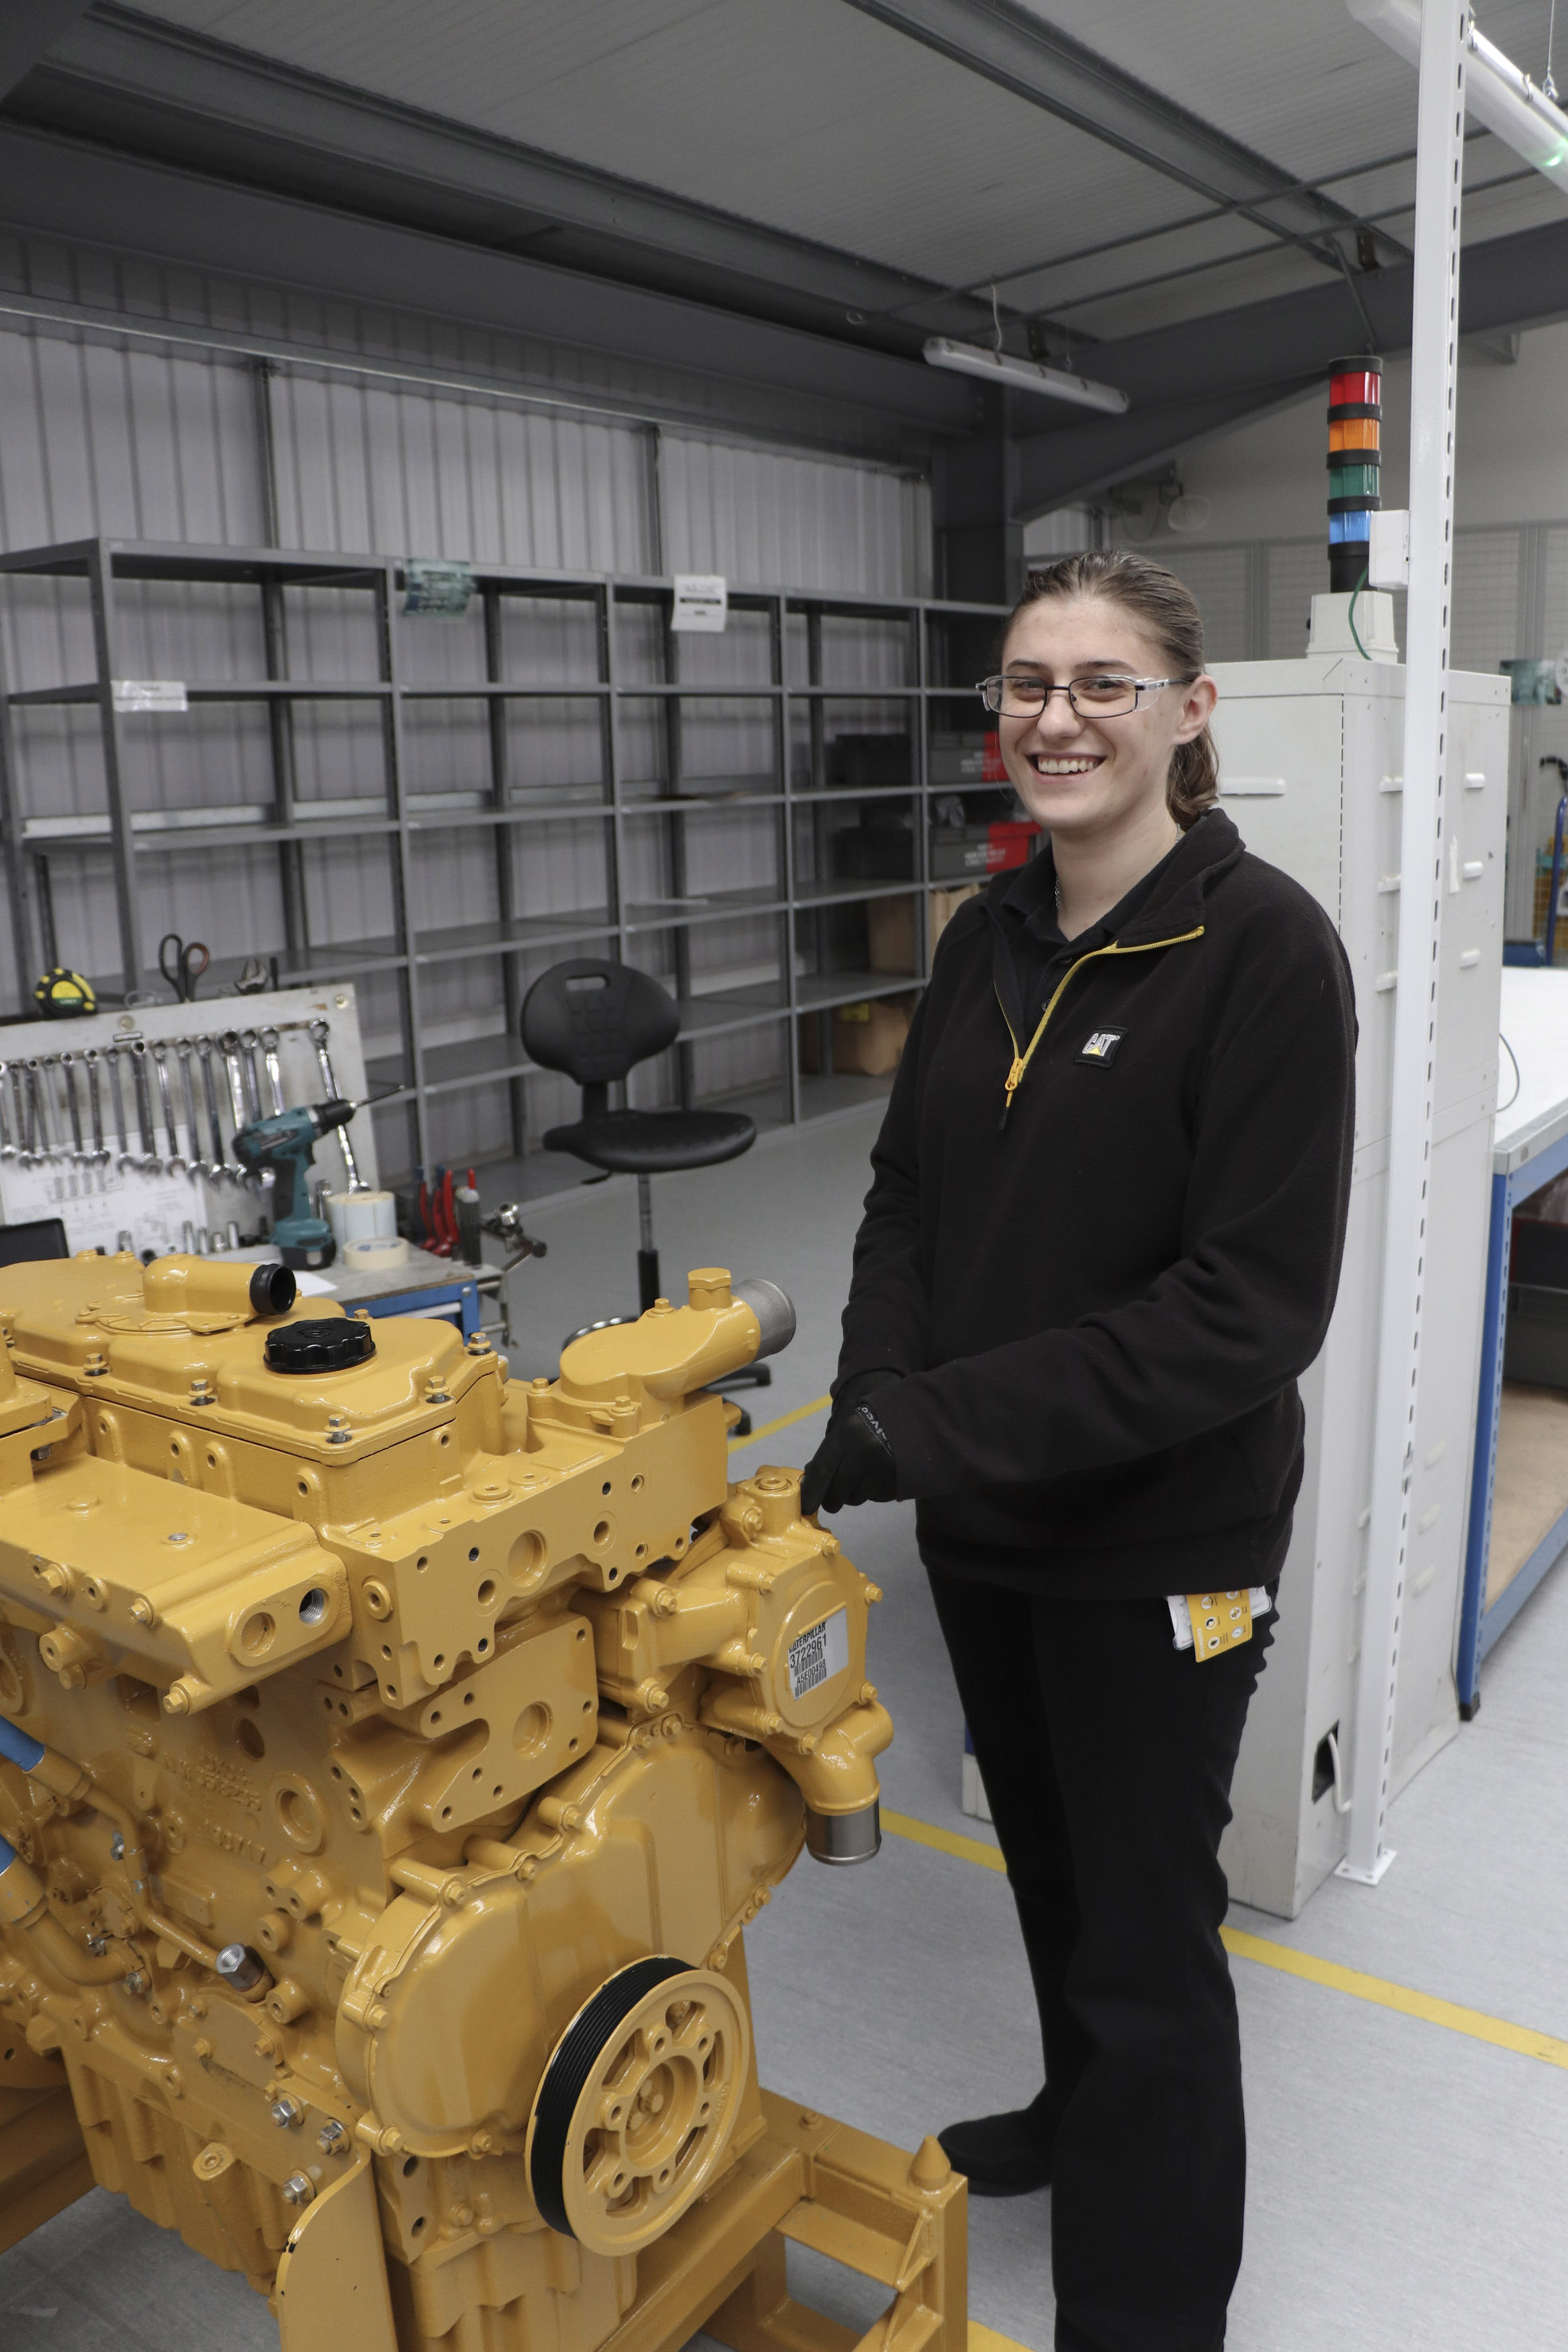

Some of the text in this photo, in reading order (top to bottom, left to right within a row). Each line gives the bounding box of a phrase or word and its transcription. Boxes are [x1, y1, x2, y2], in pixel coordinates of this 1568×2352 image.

[1082, 1033, 1118, 1057] CAT
[789, 1633, 827, 1669] 3722961
[796, 1659, 827, 1686] A5E00498
